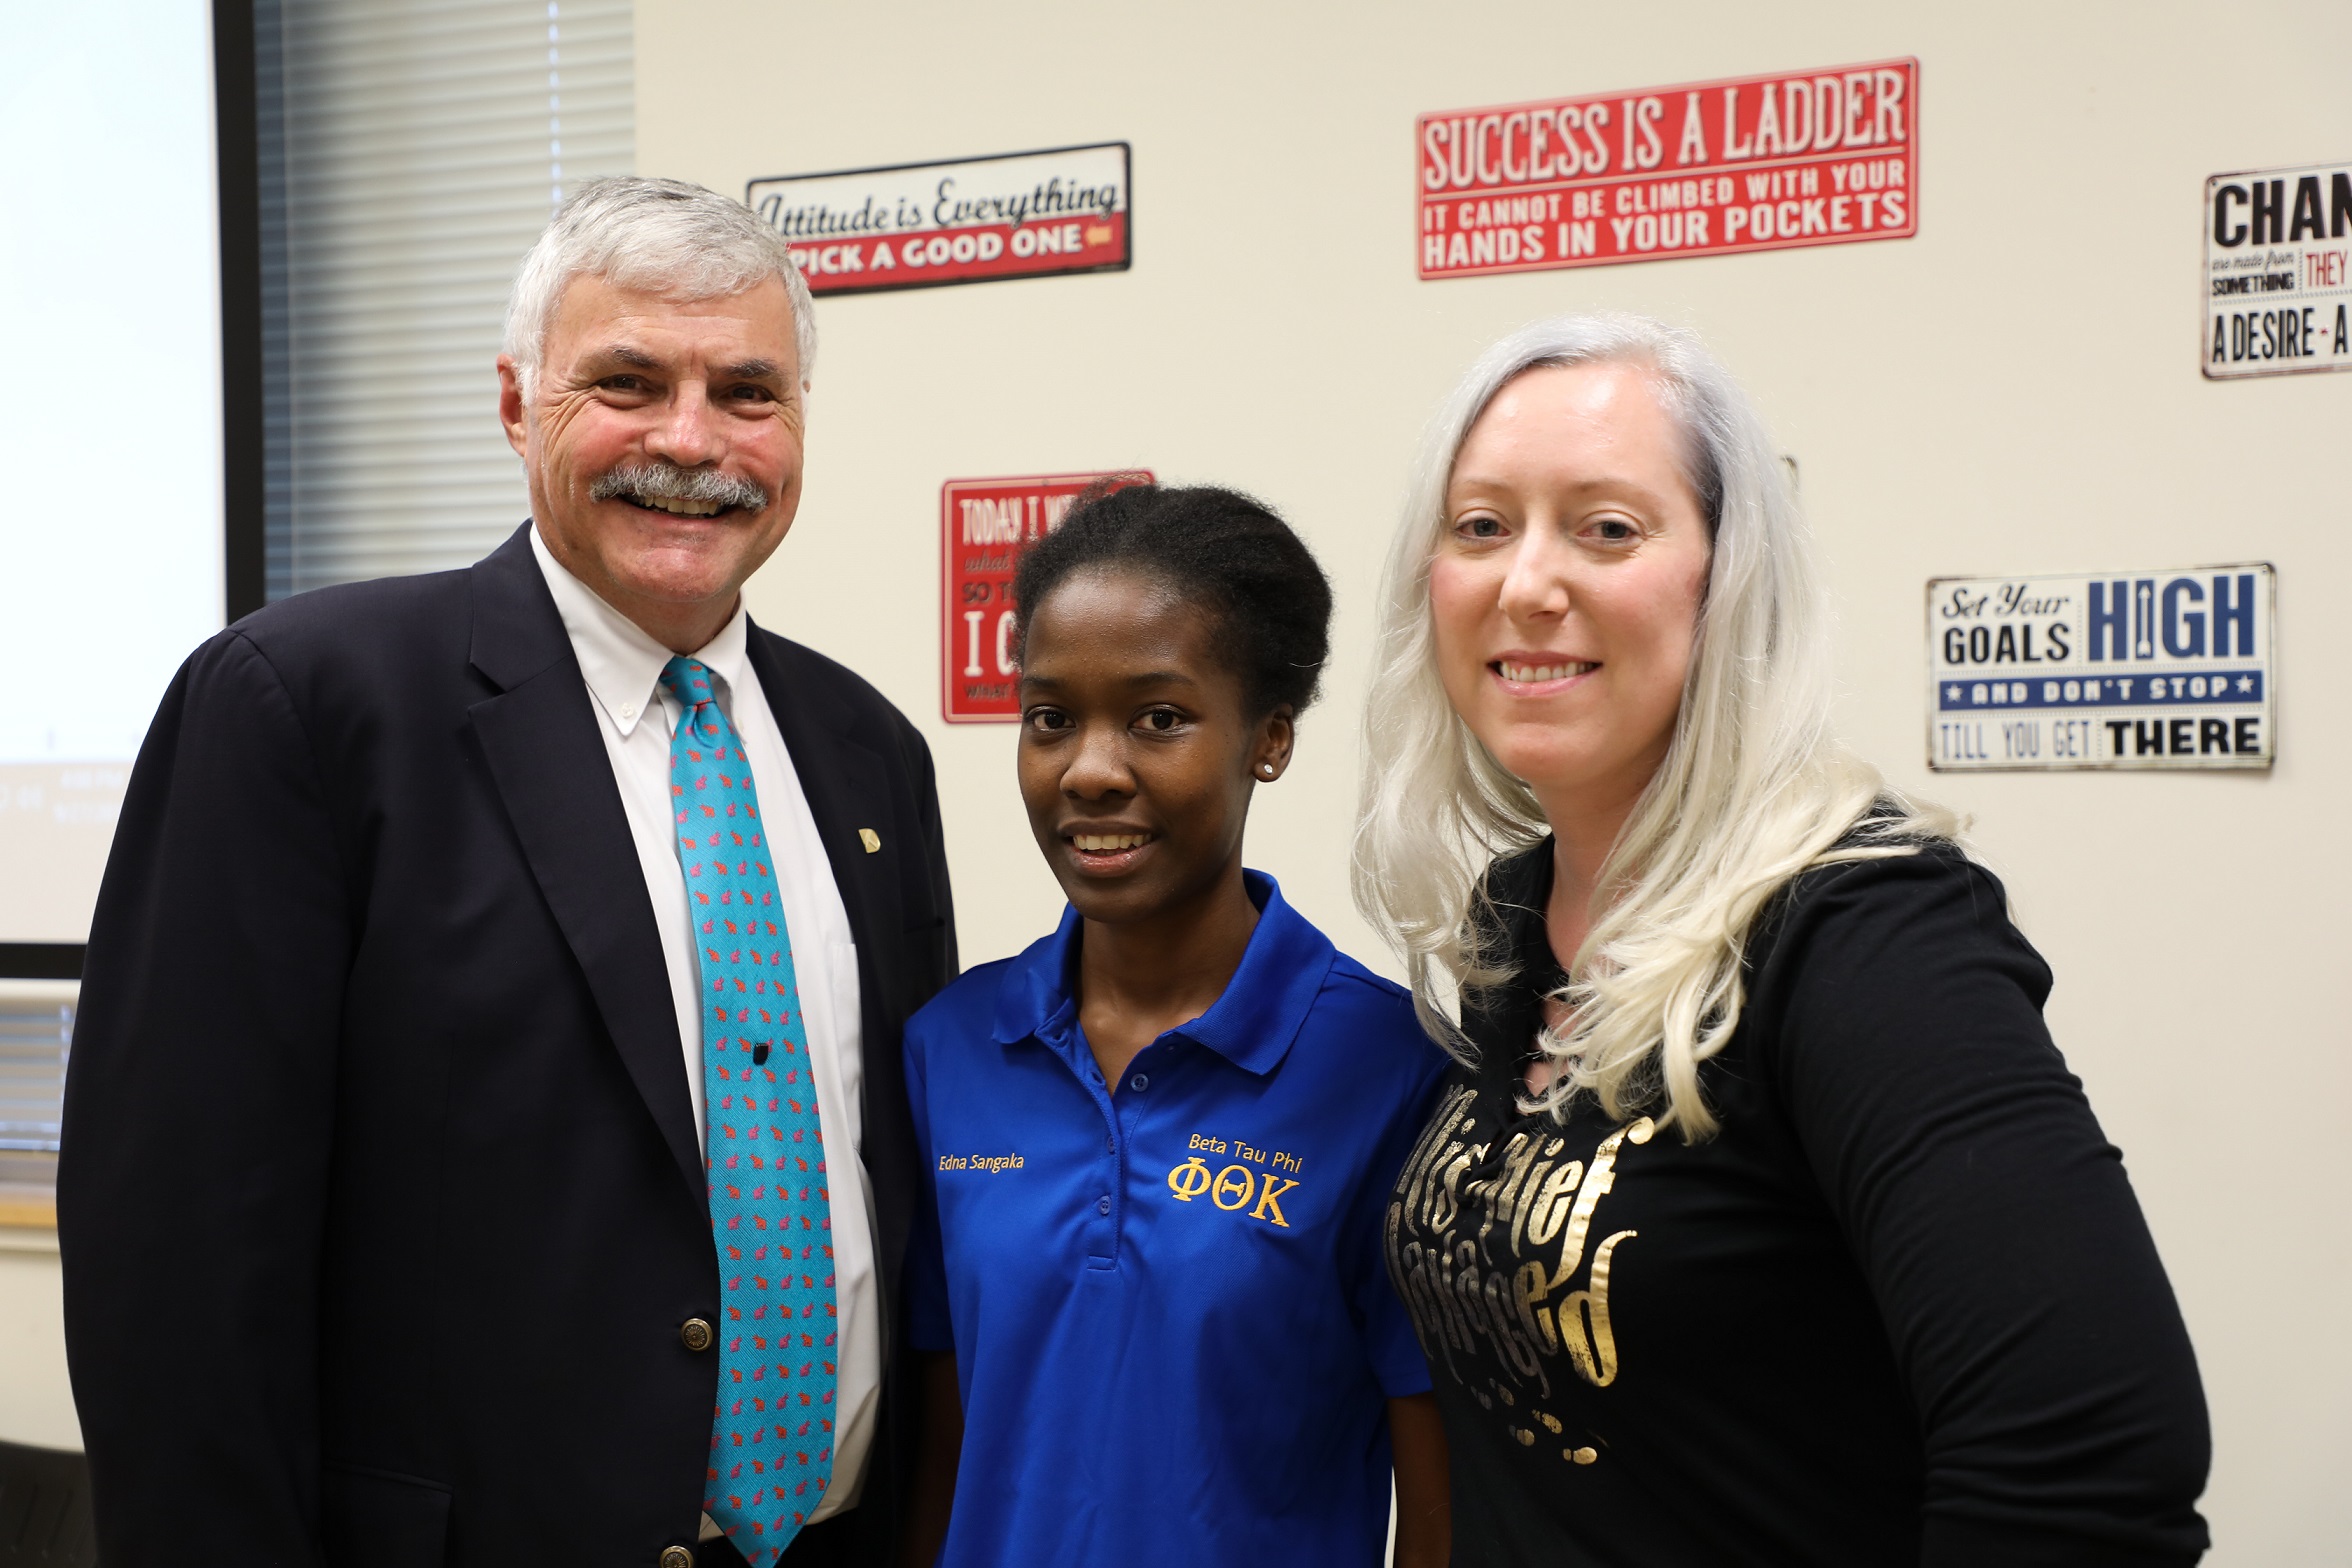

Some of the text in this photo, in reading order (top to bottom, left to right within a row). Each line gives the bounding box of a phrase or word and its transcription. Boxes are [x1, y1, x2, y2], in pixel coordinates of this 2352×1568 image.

[1423, 69, 1906, 191] SUCCESS IS A LADDER
[898, 195, 922, 228] is
[933, 177, 1119, 230] Everything
[1424, 159, 1905, 233] IT CANNOT BE CLIMBED WITH YOUR
[788, 223, 1082, 276] PICK A GOOD ONE
[1424, 190, 1906, 269] HANDS IN YOUR POCKETS
[2233, 251, 2262, 270] made
[2264, 249, 2294, 273] from
[2305, 249, 2348, 287] THEY
[2212, 271, 2294, 296] SOMETHING
[2213, 304, 2348, 363] A DESIRE A
[959, 497, 1023, 546] TODAY
[964, 549, 1010, 572] what
[963, 582, 991, 604] SO
[1942, 583, 2070, 618] Set Your
[2087, 574, 2256, 662] HIGH
[963, 611, 984, 677] I
[1944, 623, 2070, 665] GOALS
[964, 684, 1010, 700] WHAT
[1971, 676, 2228, 705] AND DON'T STOP
[1942, 718, 2261, 760] TILL YOU GET THERE
[938, 1154, 1024, 1173] Edna Sangaka
[1188, 1133, 1302, 1174] Beta Tau Phi
